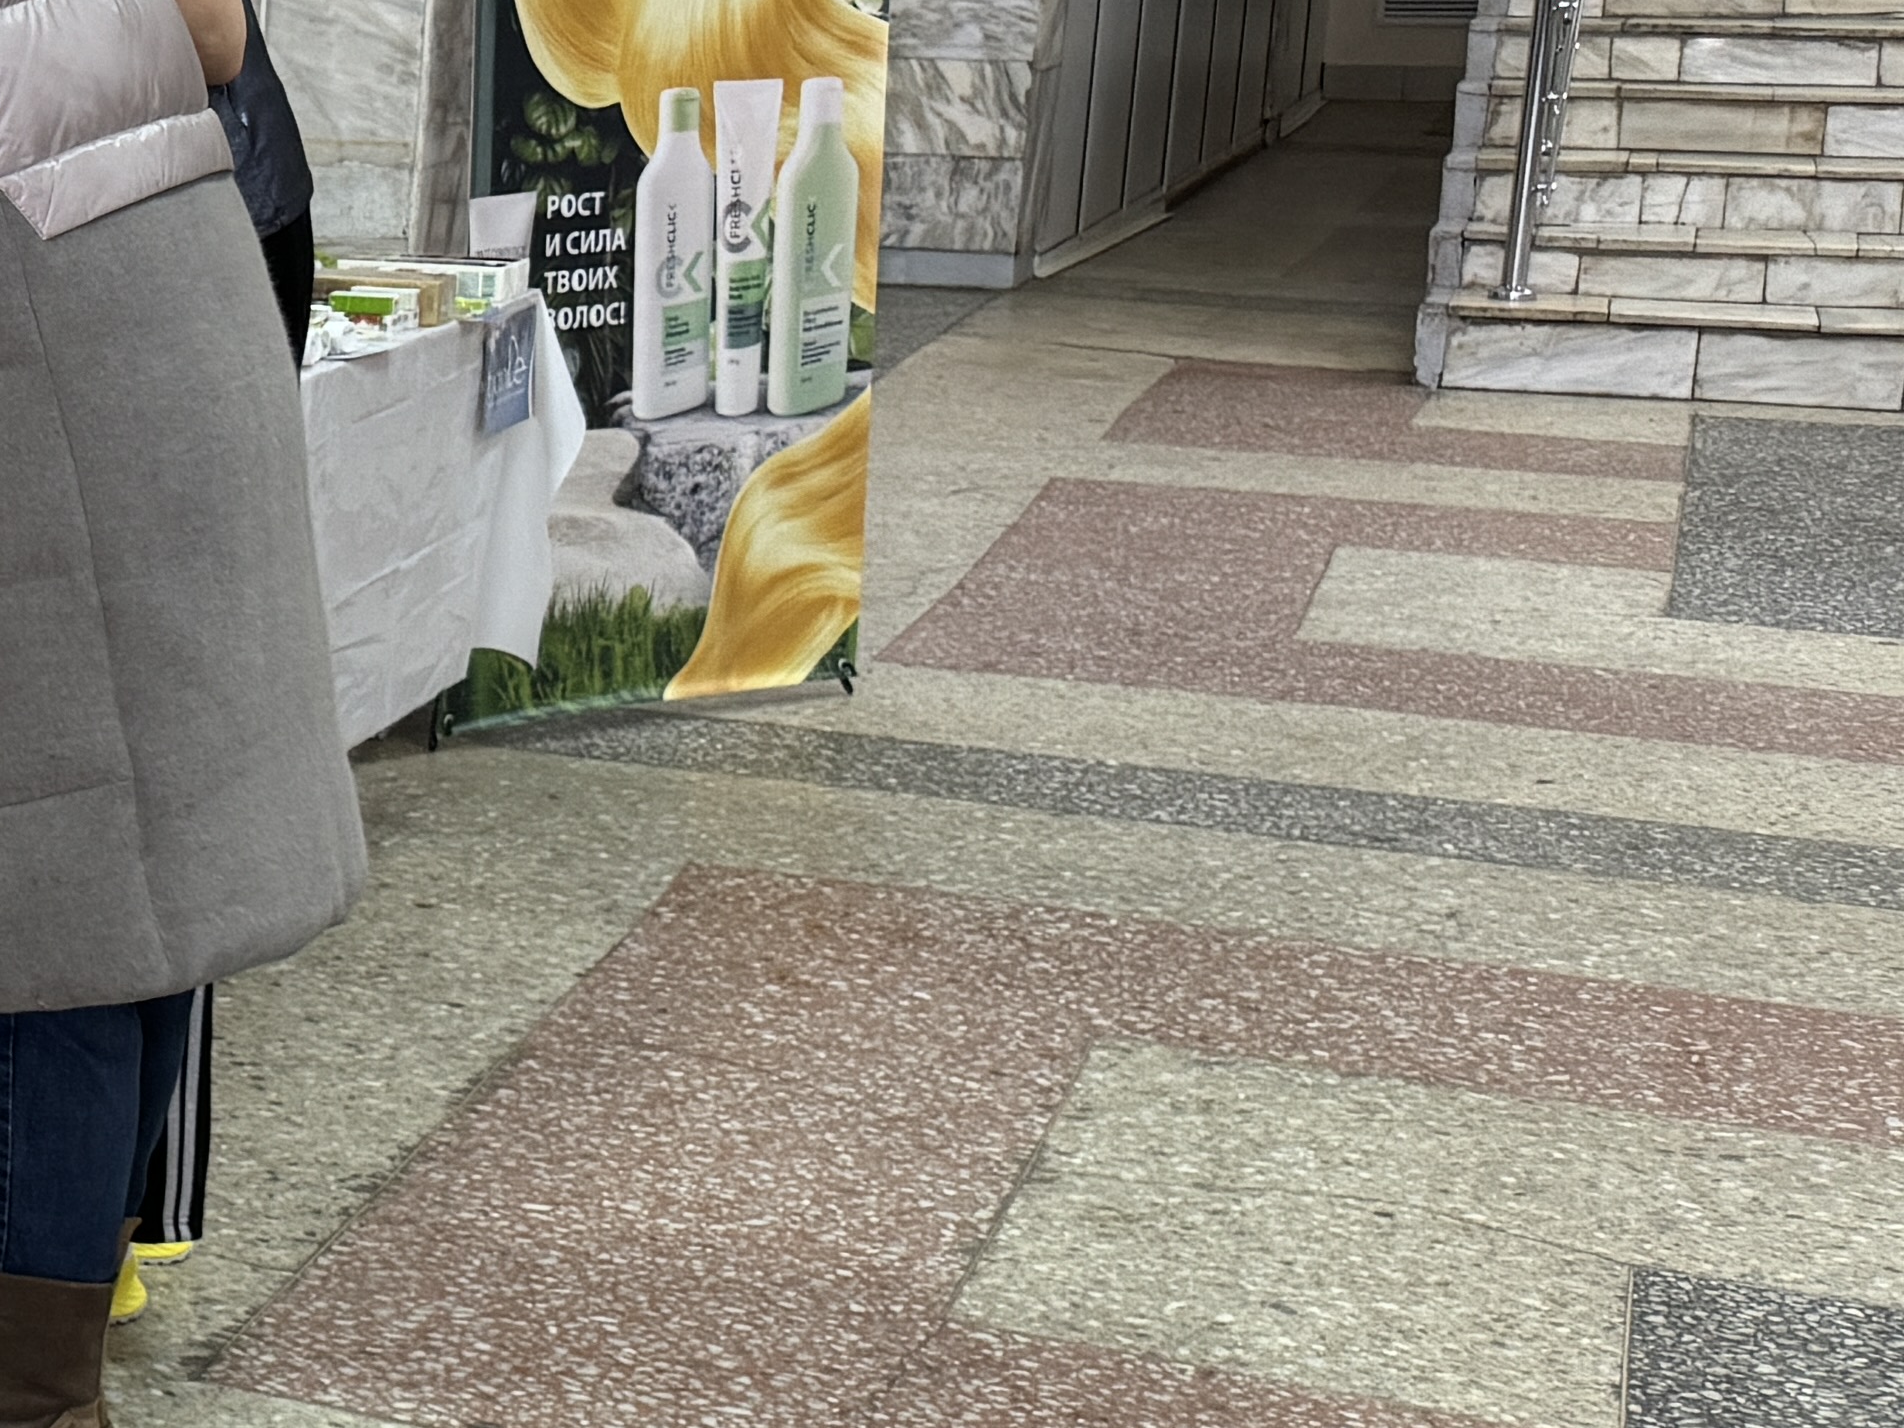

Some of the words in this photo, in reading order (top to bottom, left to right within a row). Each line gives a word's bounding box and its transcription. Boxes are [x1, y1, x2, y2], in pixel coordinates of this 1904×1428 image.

[547, 192, 605, 219] РОСТ
[545, 233, 560, 257] И
[566, 228, 627, 255] СИЛА
[544, 266, 619, 294] ТВОИХ
